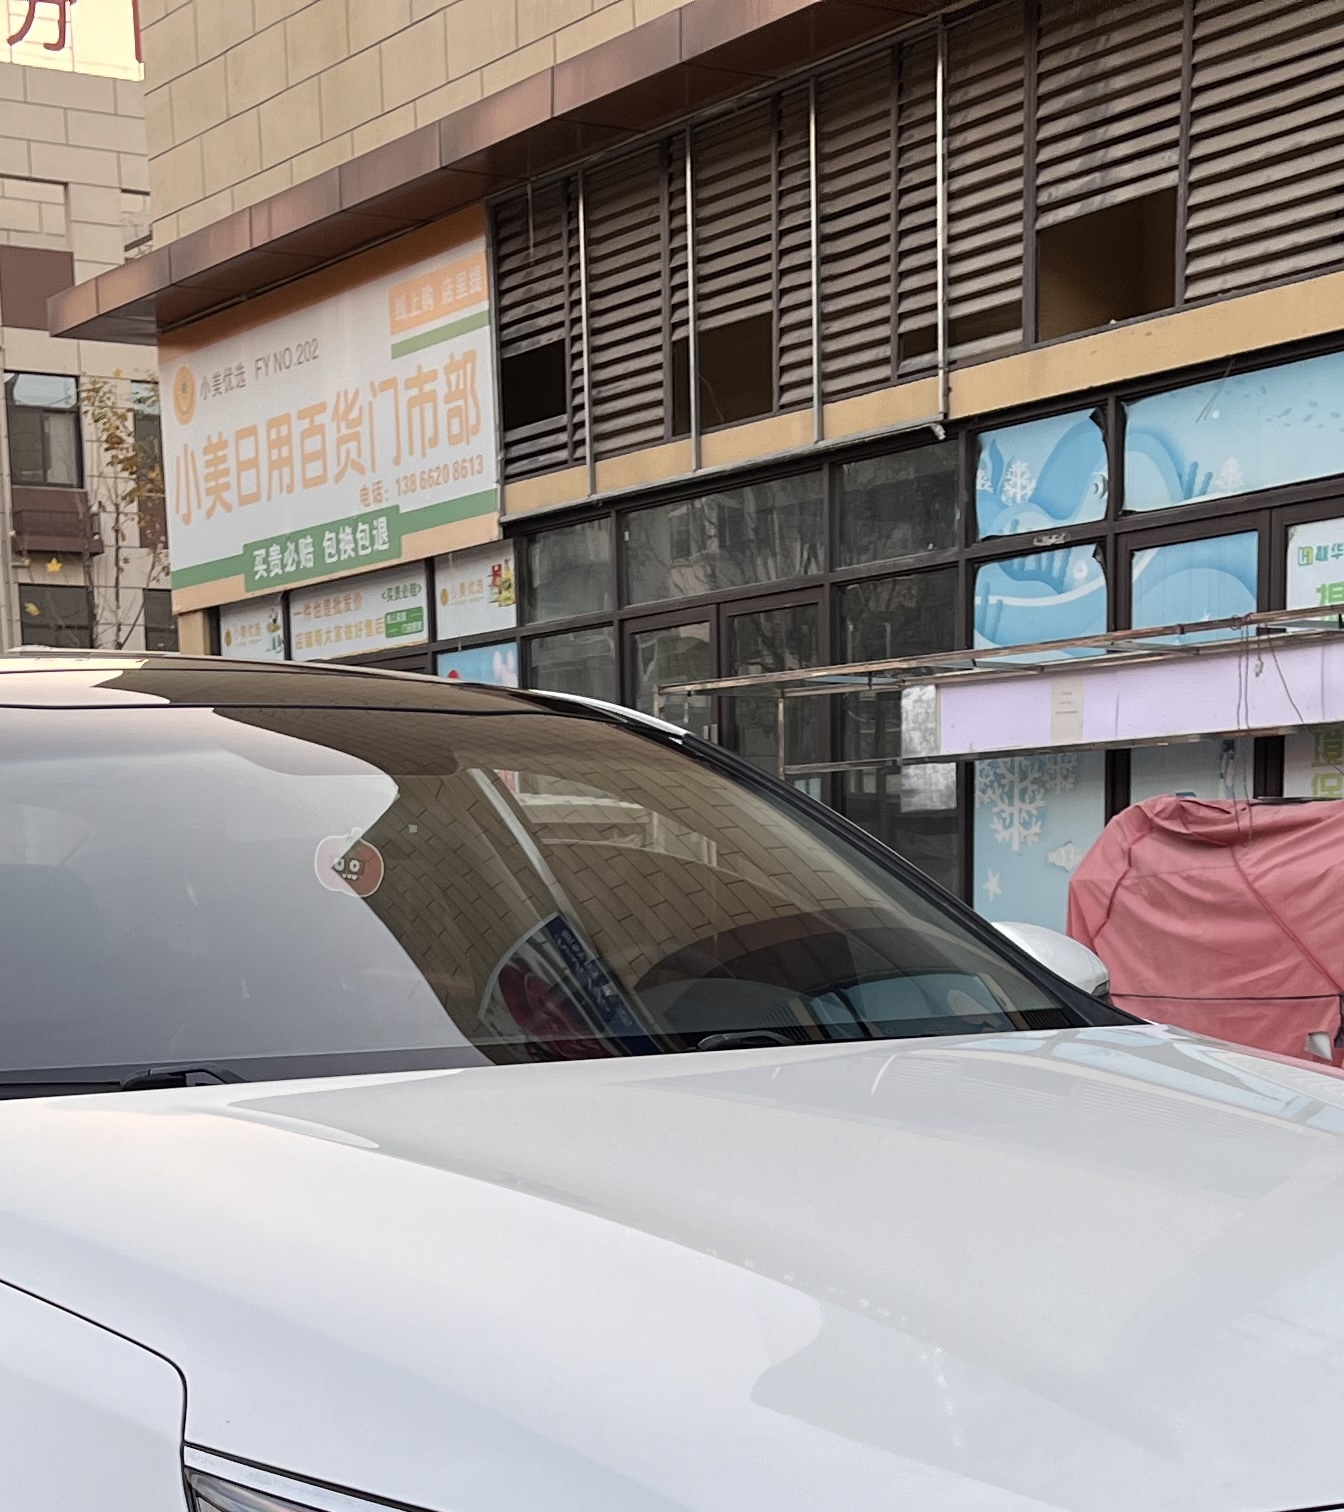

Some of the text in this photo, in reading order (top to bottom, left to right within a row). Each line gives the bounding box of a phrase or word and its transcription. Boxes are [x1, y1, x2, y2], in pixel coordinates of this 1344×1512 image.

[200, 362, 247, 400] 小美优选
[175, 349, 482, 526] 小美日用百货门市部
[253, 516, 390, 580] 买贵必赔 包换包退
